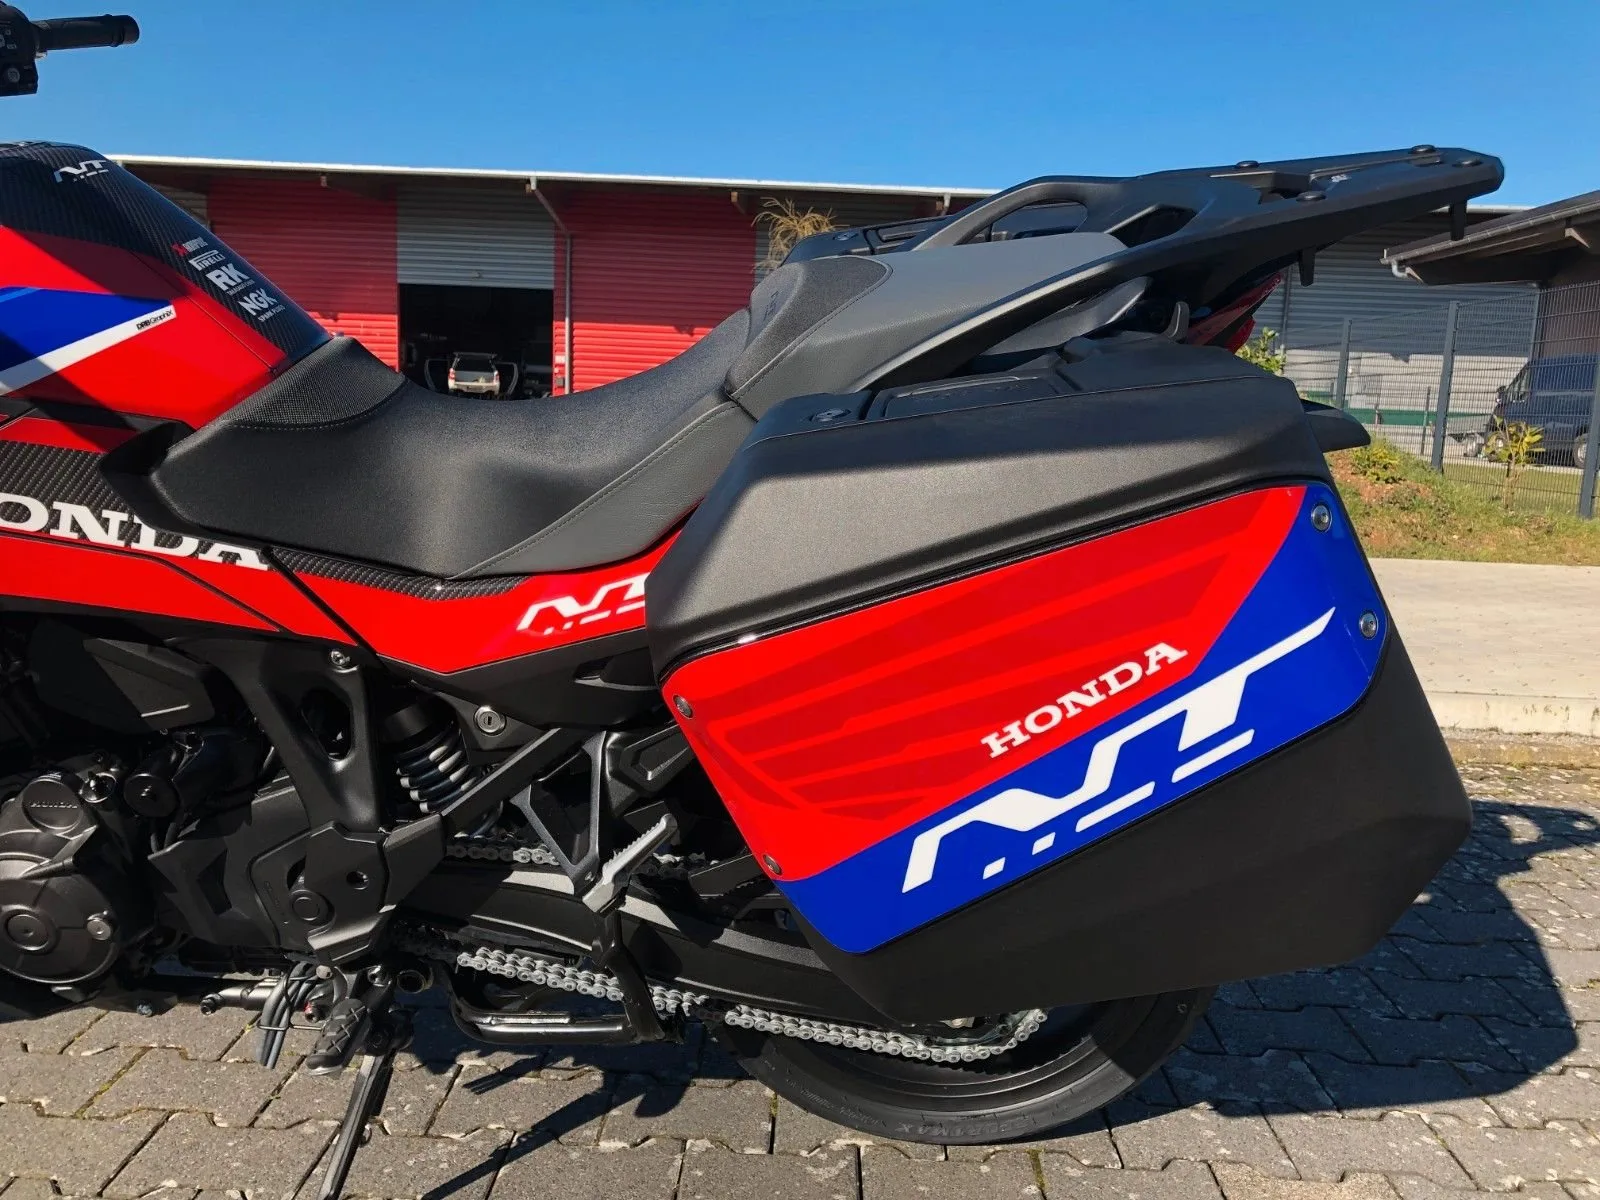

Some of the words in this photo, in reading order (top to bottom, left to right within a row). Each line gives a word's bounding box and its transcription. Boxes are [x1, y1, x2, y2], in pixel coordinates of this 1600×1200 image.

[188, 249, 226, 271] PIRELLI
[205, 262, 250, 291] RK
[237, 287, 278, 316] NGK
[980, 642, 1188, 758] HONDA
